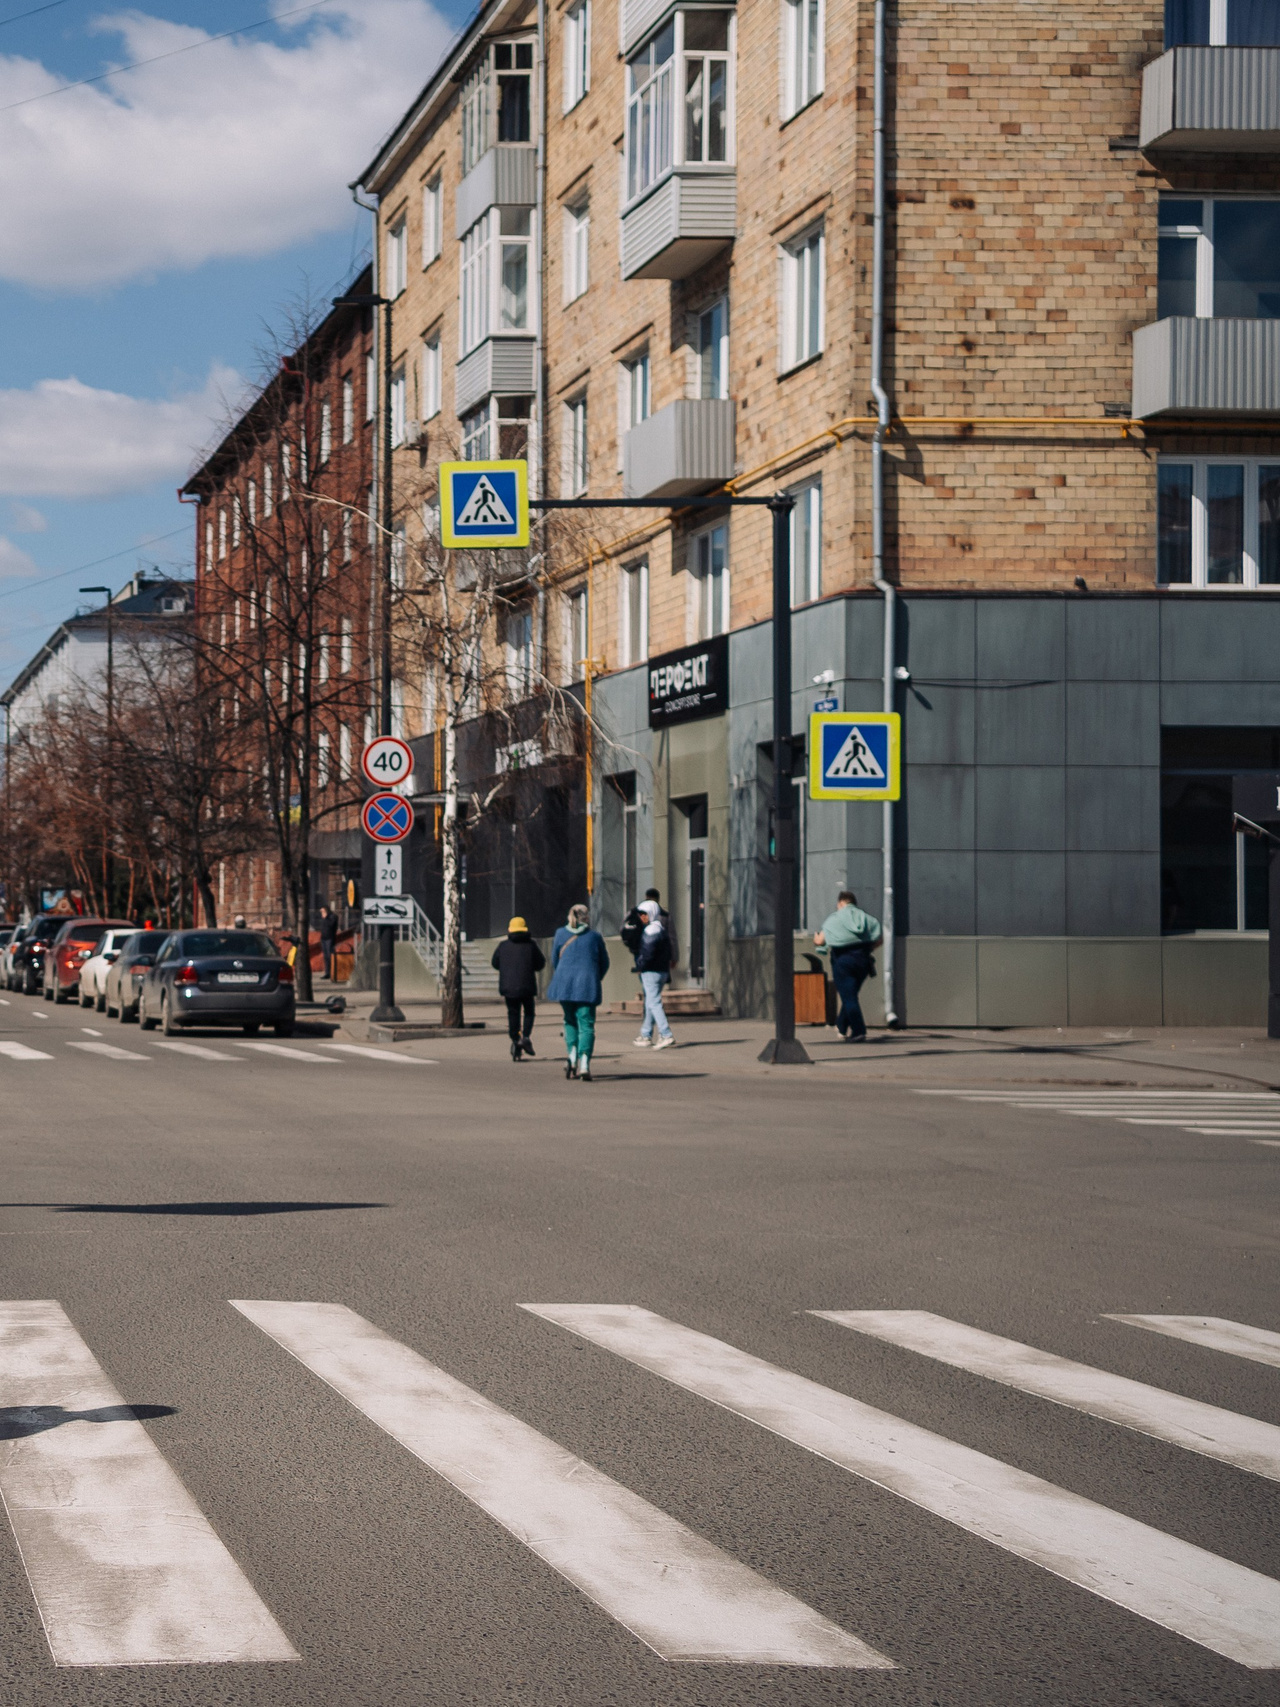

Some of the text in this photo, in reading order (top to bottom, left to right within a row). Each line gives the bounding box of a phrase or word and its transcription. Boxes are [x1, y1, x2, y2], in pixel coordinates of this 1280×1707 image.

[650, 653, 709, 699] ПЕРФЕКТ
[373, 751, 402, 771] 40
[380, 868, 398, 880] 20
